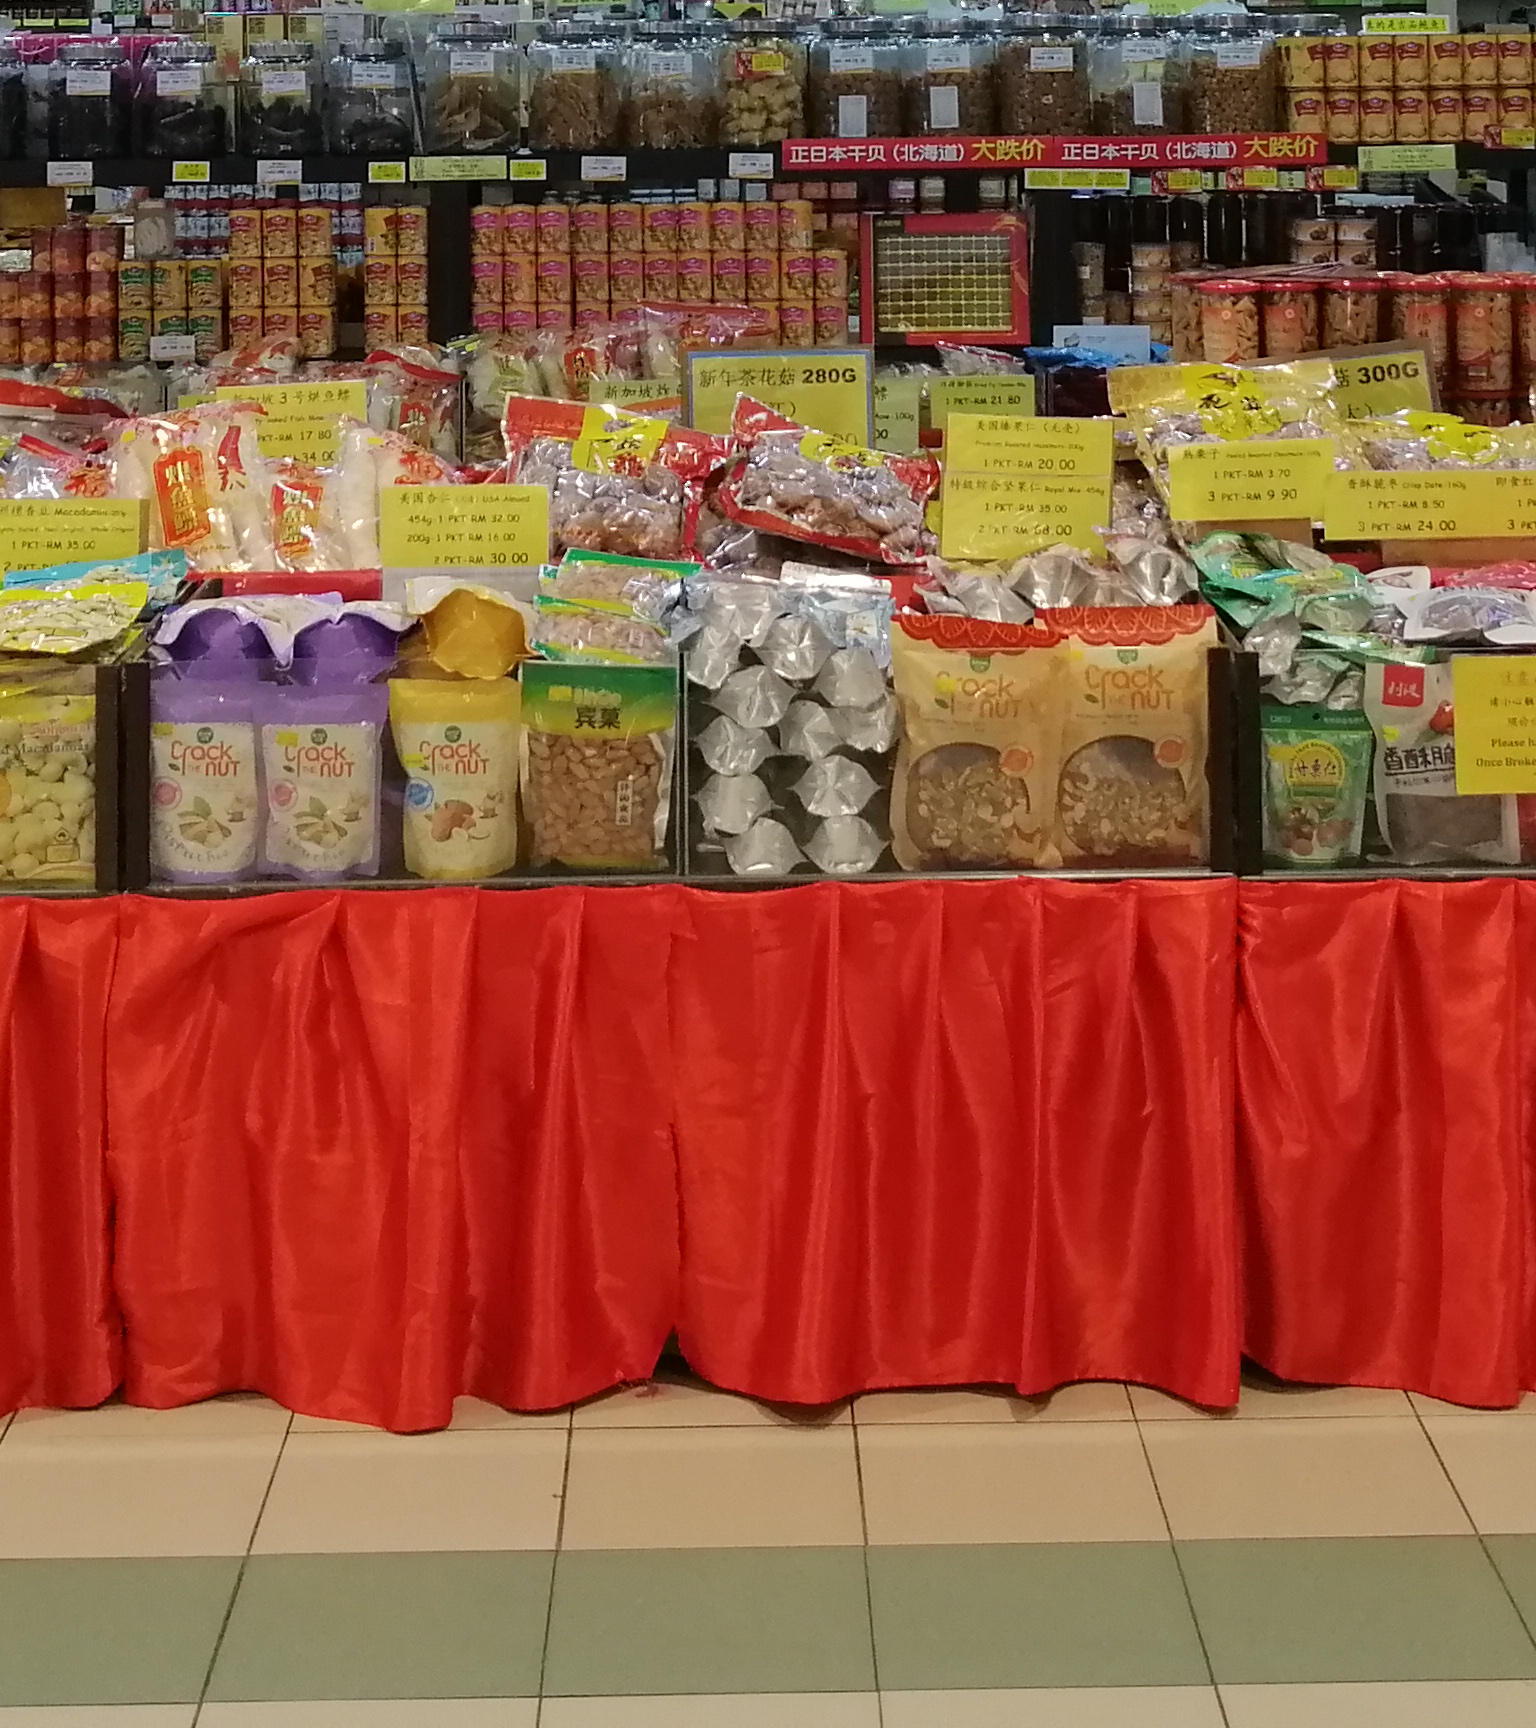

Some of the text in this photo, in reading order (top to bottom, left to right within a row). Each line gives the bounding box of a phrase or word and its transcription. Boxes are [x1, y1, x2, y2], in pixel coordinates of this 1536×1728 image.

[802, 367, 858, 385] 280G
[1357, 360, 1420, 385] 300G
[604, 383, 681, 400] 新加坡炸
[482, 495, 500, 503] USA
[1207, 490, 1216, 503] 3
[1357, 520, 1366, 533] 3
[1417, 519, 1457, 532] 24.00
[1507, 518, 1516, 531] 3
[1086, 663, 1165, 710] Crack
[1491, 737, 1525, 748] Please
[171, 740, 233, 776] Crack
[419, 739, 481, 775] Crack
[1476, 757, 1503, 768] Once
